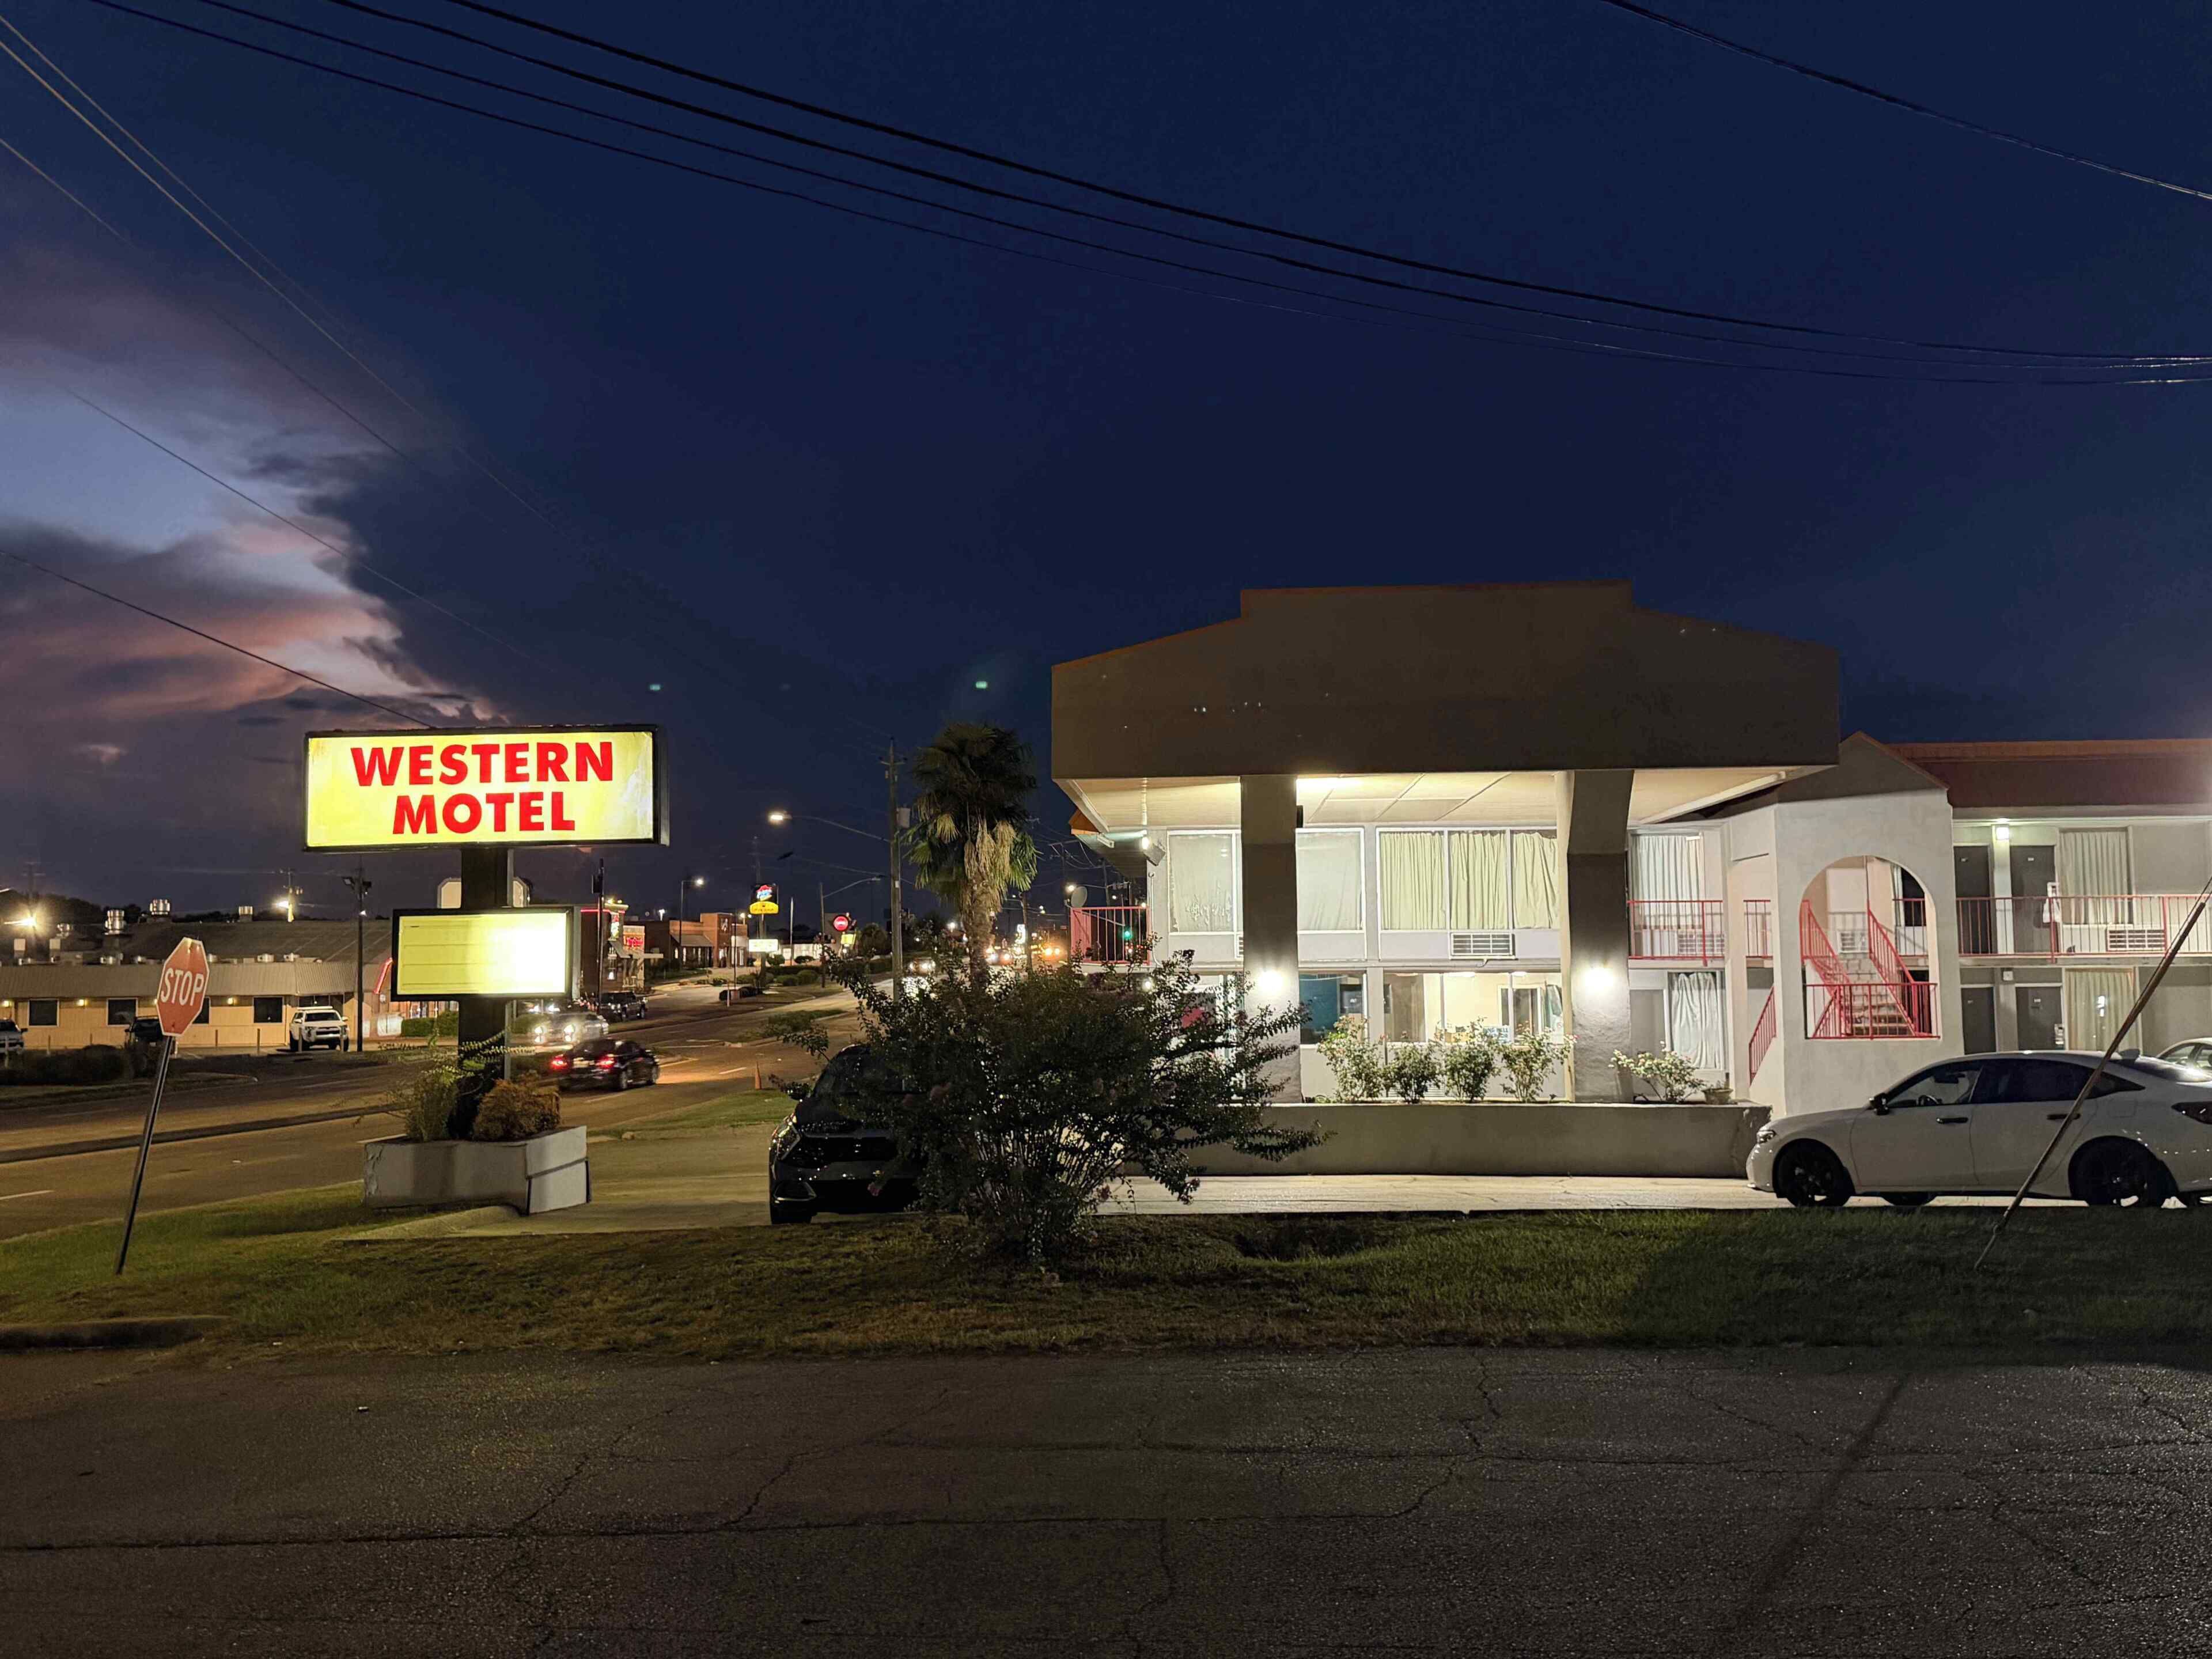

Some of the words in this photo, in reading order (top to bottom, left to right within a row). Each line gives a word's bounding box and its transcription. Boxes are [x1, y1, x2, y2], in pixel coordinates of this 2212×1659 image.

[351, 741, 613, 786] WESTERN
[392, 791, 575, 834] MOTEL
[161, 968, 204, 1006] STOP
